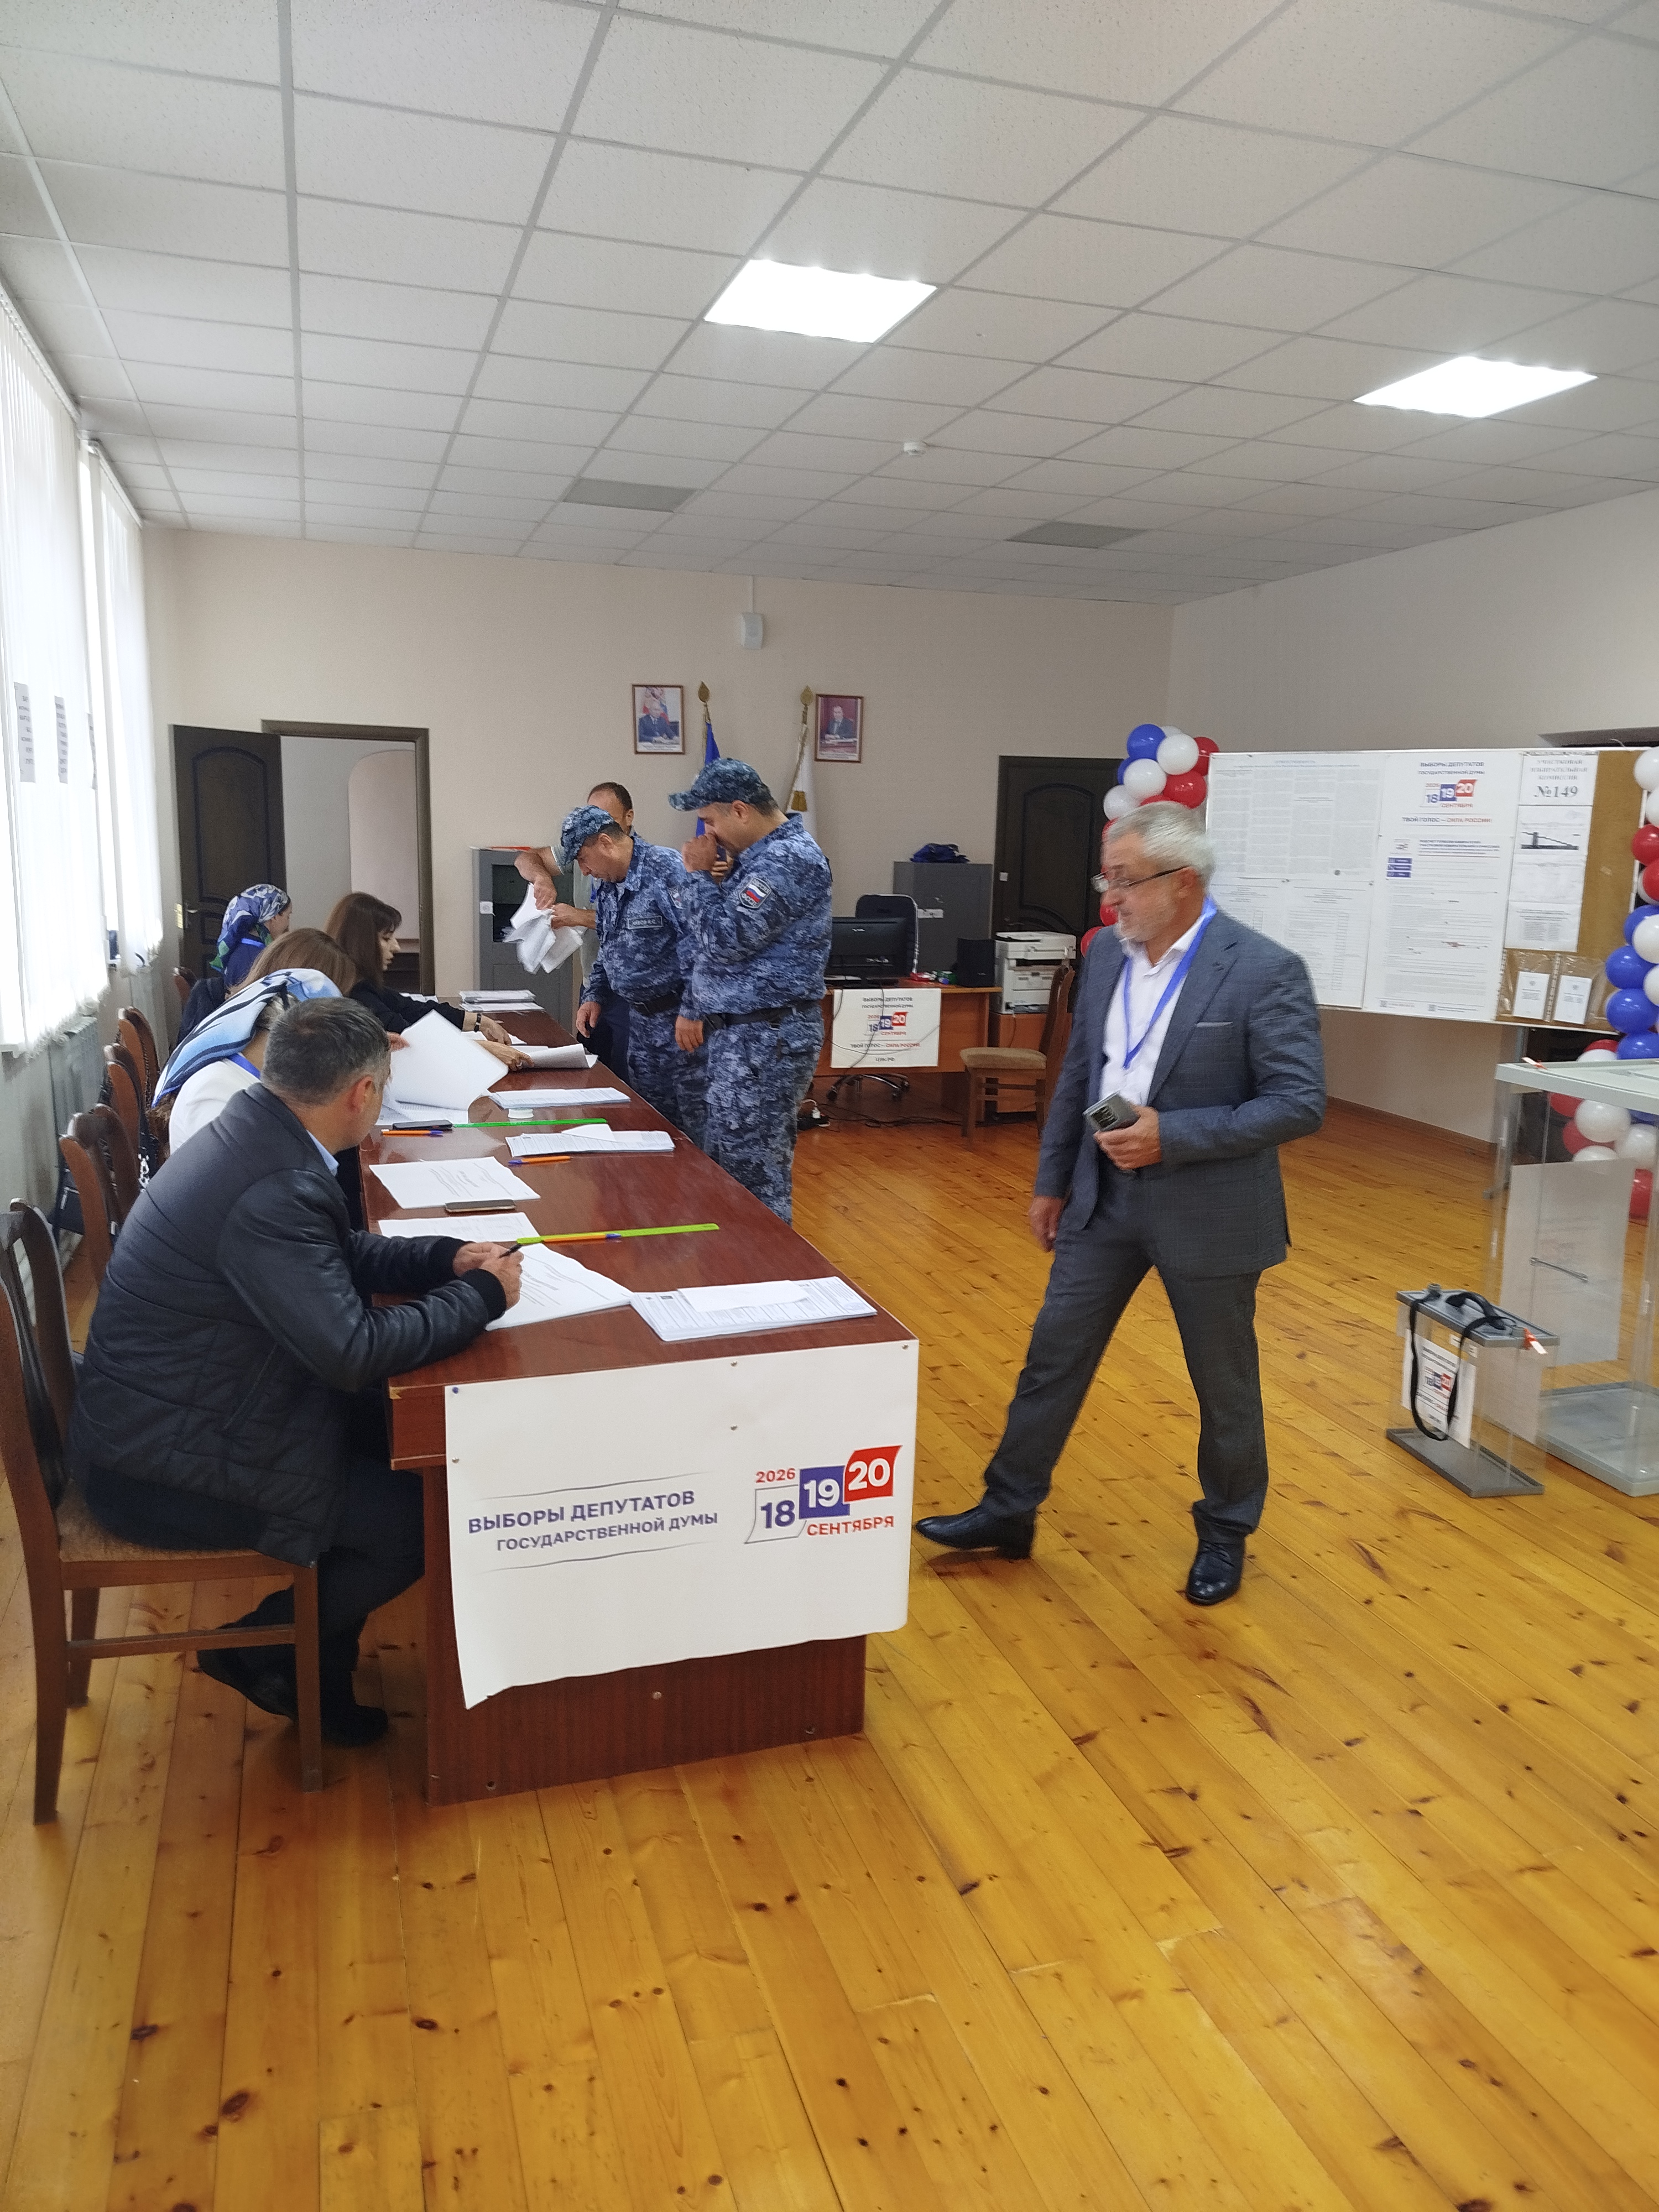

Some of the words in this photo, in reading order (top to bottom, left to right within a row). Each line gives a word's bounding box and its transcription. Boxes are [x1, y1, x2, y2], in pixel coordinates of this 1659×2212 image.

[1426, 794, 1438, 803] 18
[1441, 788, 1454, 799] 19
[1457, 782, 1474, 794] 20
[1533, 786, 1578, 797] №149
[880, 1019, 891, 1028] 19
[893, 1014, 906, 1024] 20
[755, 1468, 796, 1483] 2026
[760, 1500, 795, 1528] 18
[804, 1479, 840, 1508] 19
[848, 1458, 890, 1491] 20
[468, 1506, 565, 1533] ВЫБОРЫ
[571, 1490, 695, 1521] ДЕПУТАТОВ
[497, 1517, 664, 1551] ГОСУДАРСТВЕННОЙ
[669, 1512, 718, 1531] ДУМЫ
[807, 1516, 894, 1536] СЕНТЯБРЯ
